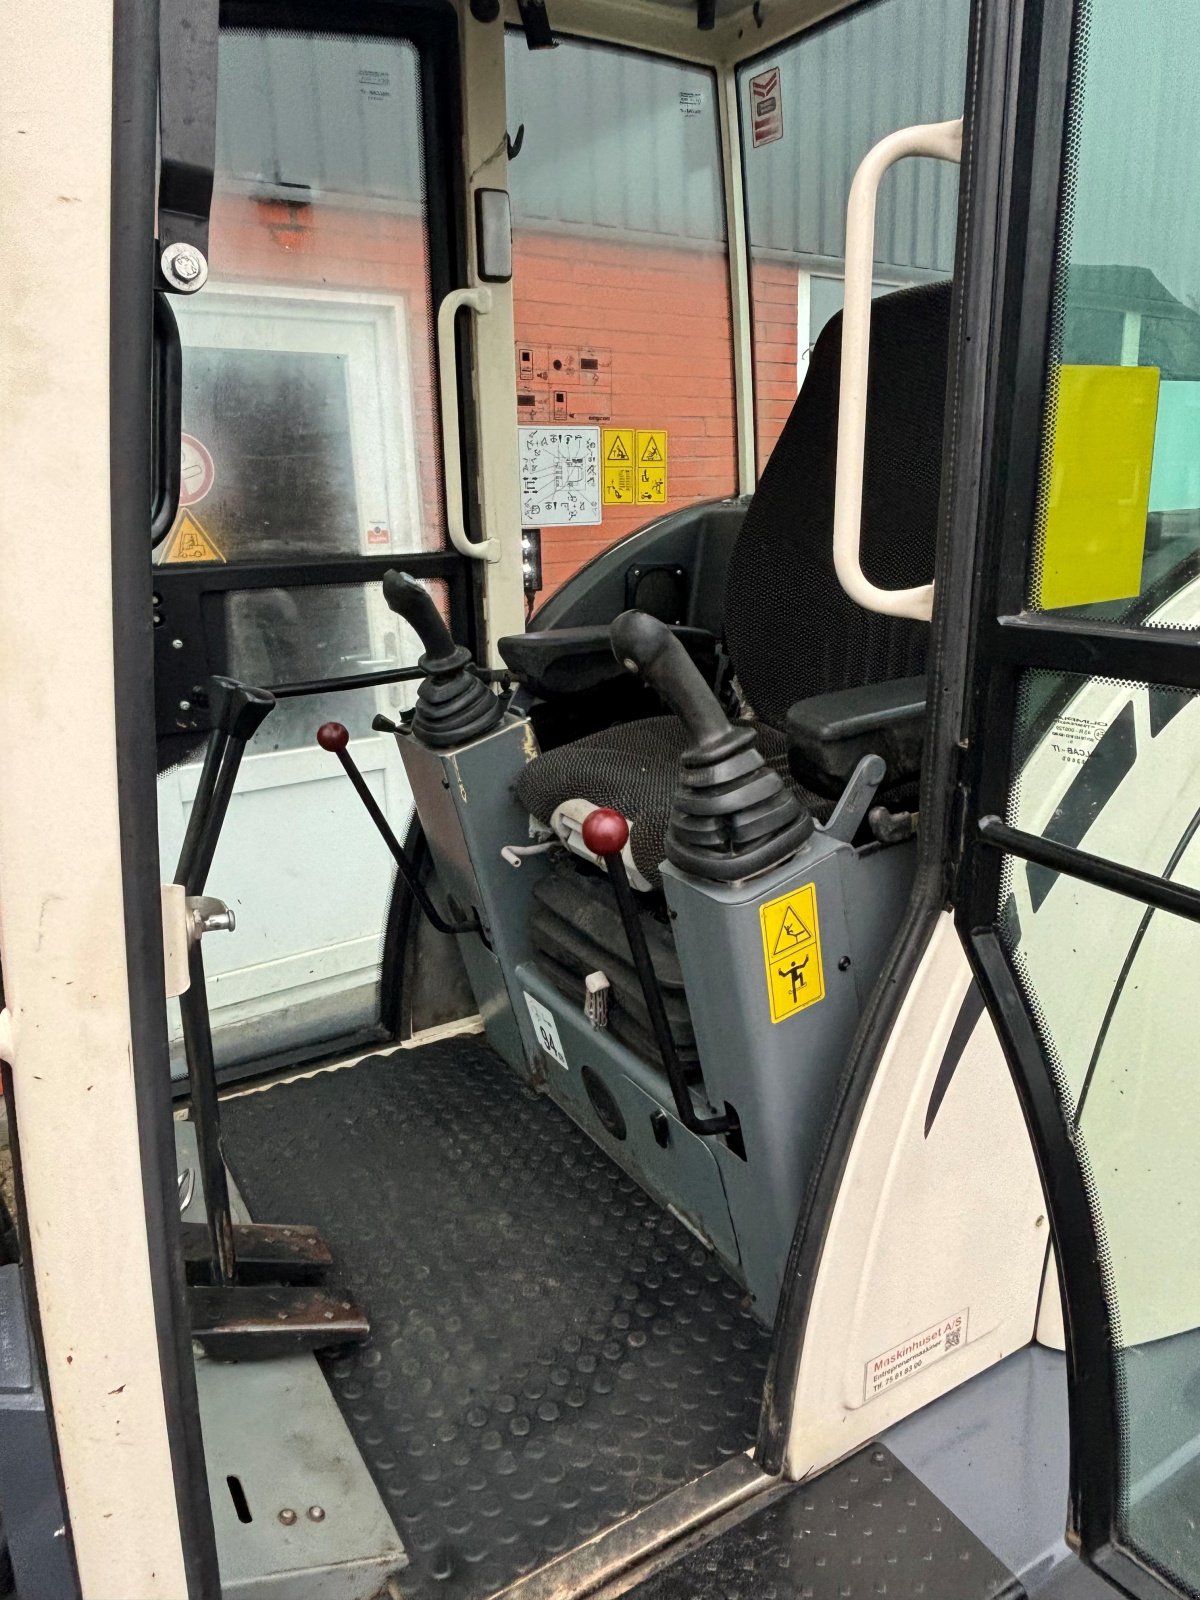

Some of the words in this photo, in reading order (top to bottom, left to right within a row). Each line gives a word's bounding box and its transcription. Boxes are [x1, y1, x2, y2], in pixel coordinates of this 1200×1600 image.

[539, 1026, 558, 1057] 94
[873, 1330, 942, 1372] Maskinhuset
[943, 1316, 962, 1334] A/S
